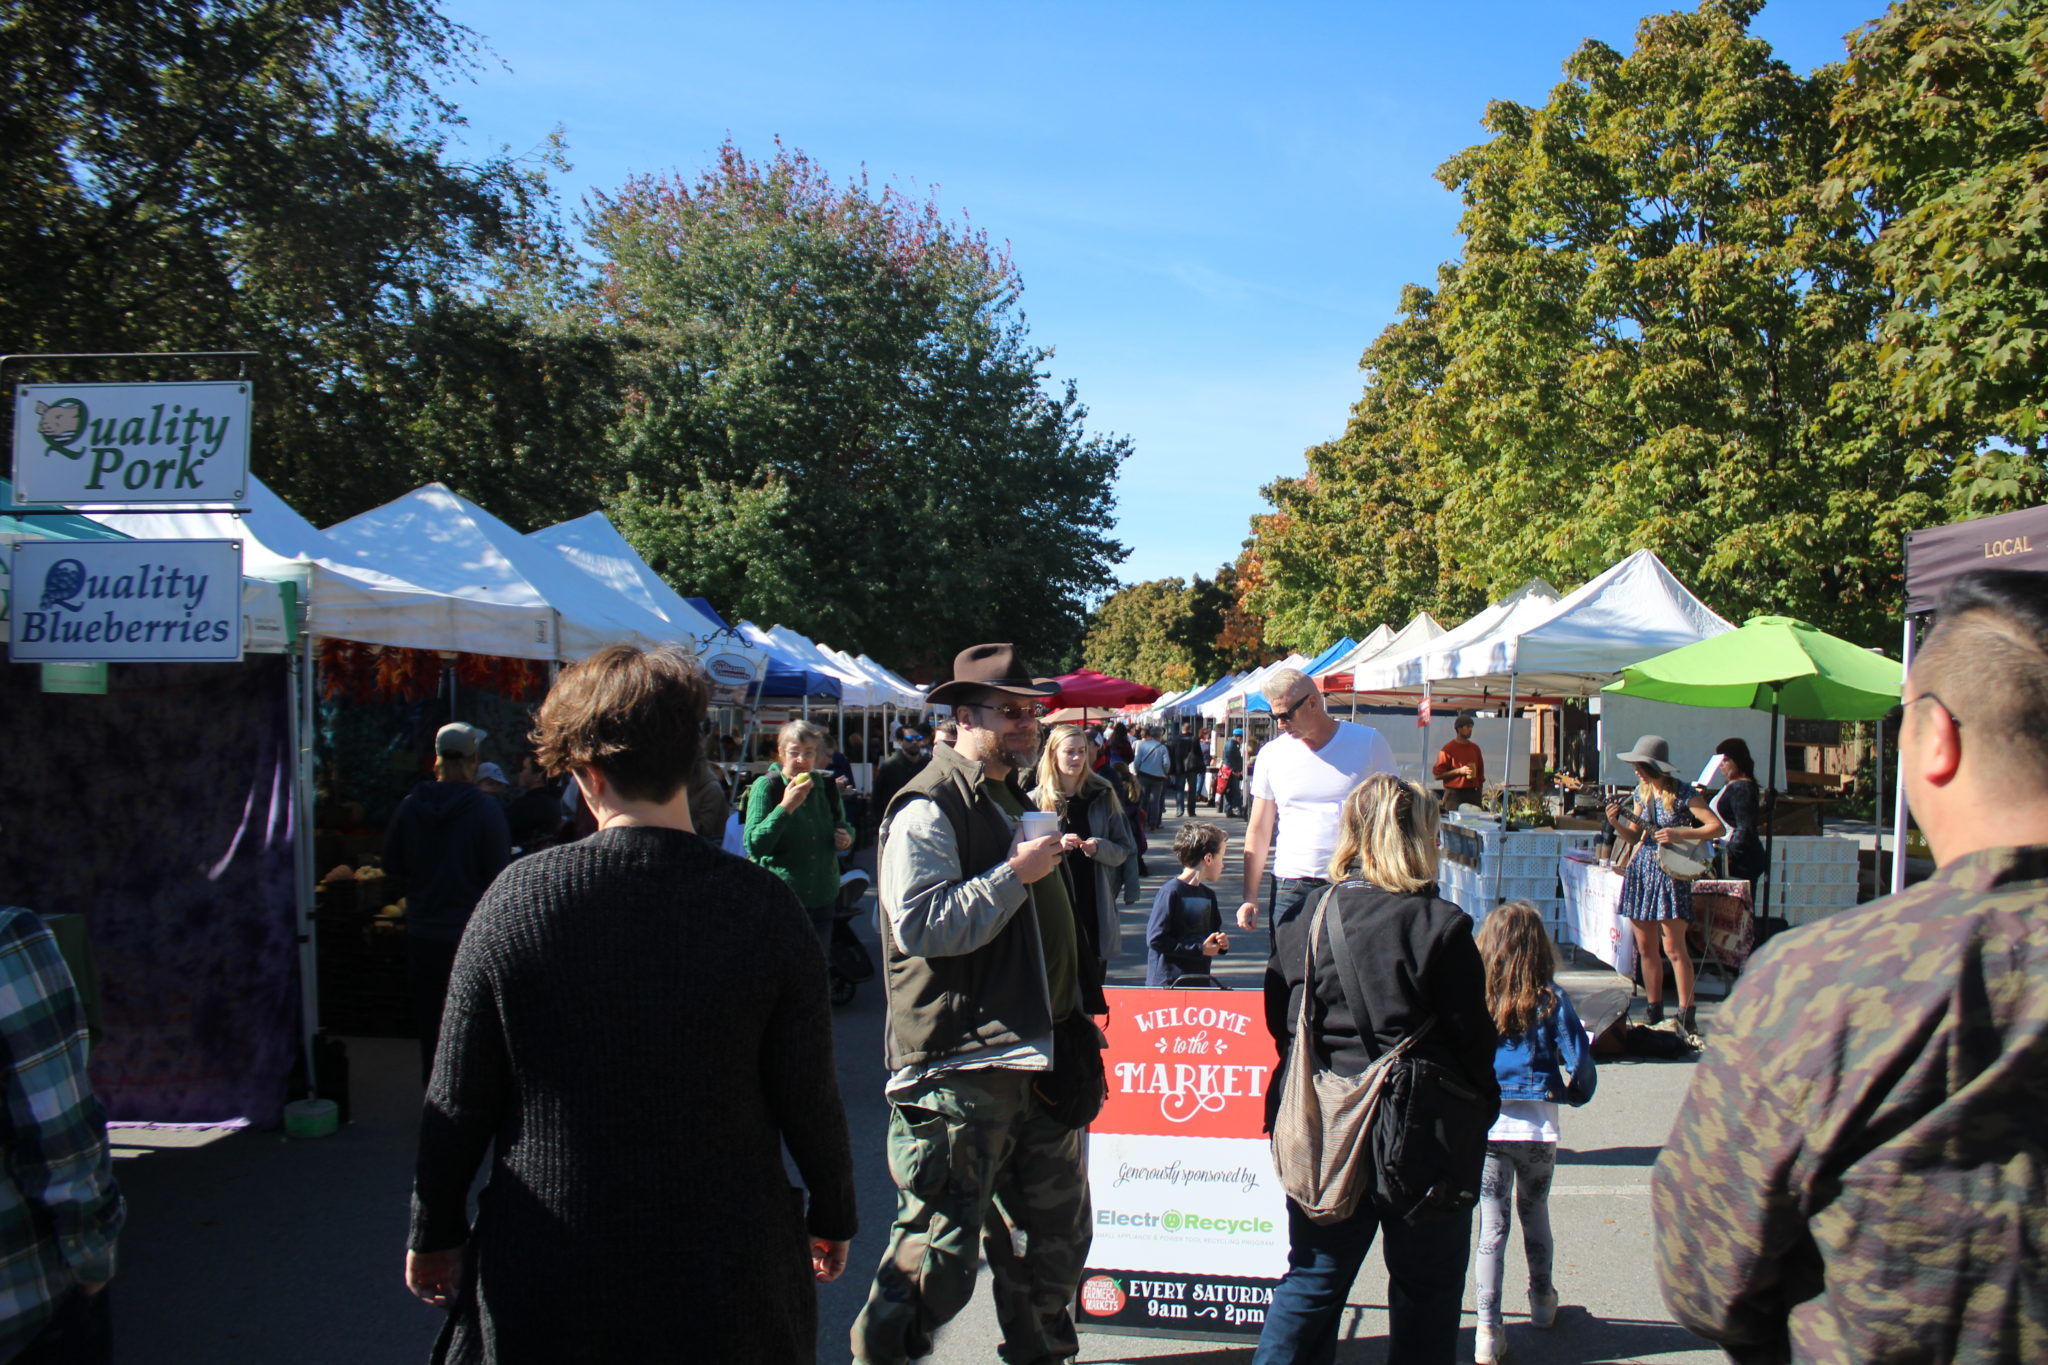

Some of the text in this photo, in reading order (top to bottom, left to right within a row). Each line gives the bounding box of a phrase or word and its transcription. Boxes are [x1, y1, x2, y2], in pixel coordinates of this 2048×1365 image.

[38, 397, 230, 460] Quality
[84, 445, 206, 490] Pork
[1984, 536, 2033, 559] LOCAL
[40, 559, 209, 612] Quality
[20, 611, 230, 644] Blueberries
[1134, 1006, 1251, 1035] WELCOME
[1173, 1030, 1209, 1054] to the
[1114, 1062, 1267, 1122] MARKET
[1113, 1160, 1260, 1193] Generously sponsored by
[1083, 1286, 1116, 1301] FARMERS
[1085, 1299, 1119, 1311] MARKETS
[1129, 1280, 1277, 1304] EVERY SATURDA
[1148, 1299, 1265, 1326] 9am 2pm
